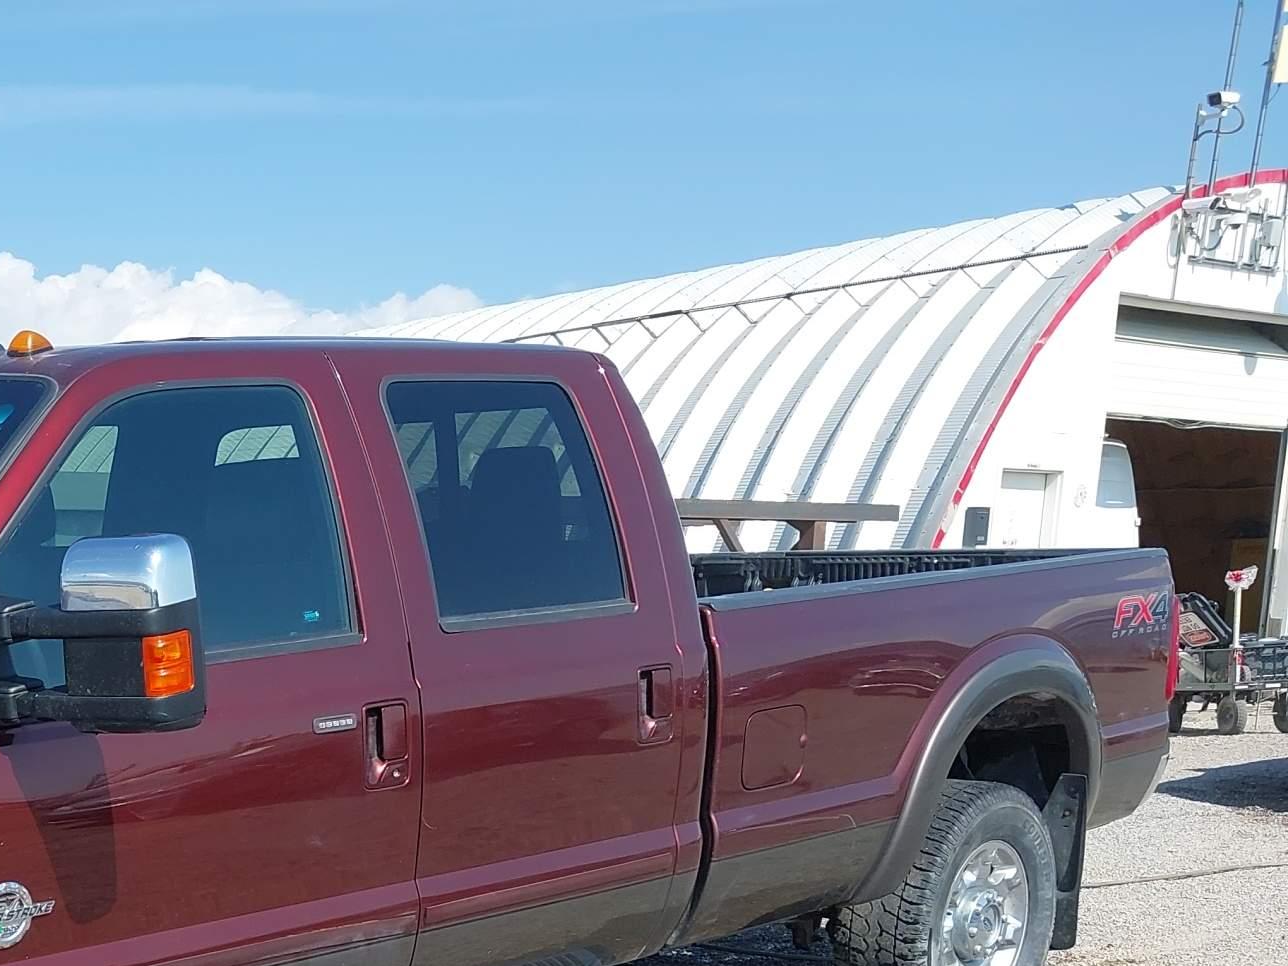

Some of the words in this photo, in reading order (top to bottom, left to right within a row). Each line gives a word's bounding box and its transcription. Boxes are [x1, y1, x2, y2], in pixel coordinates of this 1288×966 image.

[1114, 591, 1169, 628] FX4
[1112, 629, 1135, 639] OFF
[1138, 622, 1169, 634] ROAD
[5, 901, 54, 921] STROKE
